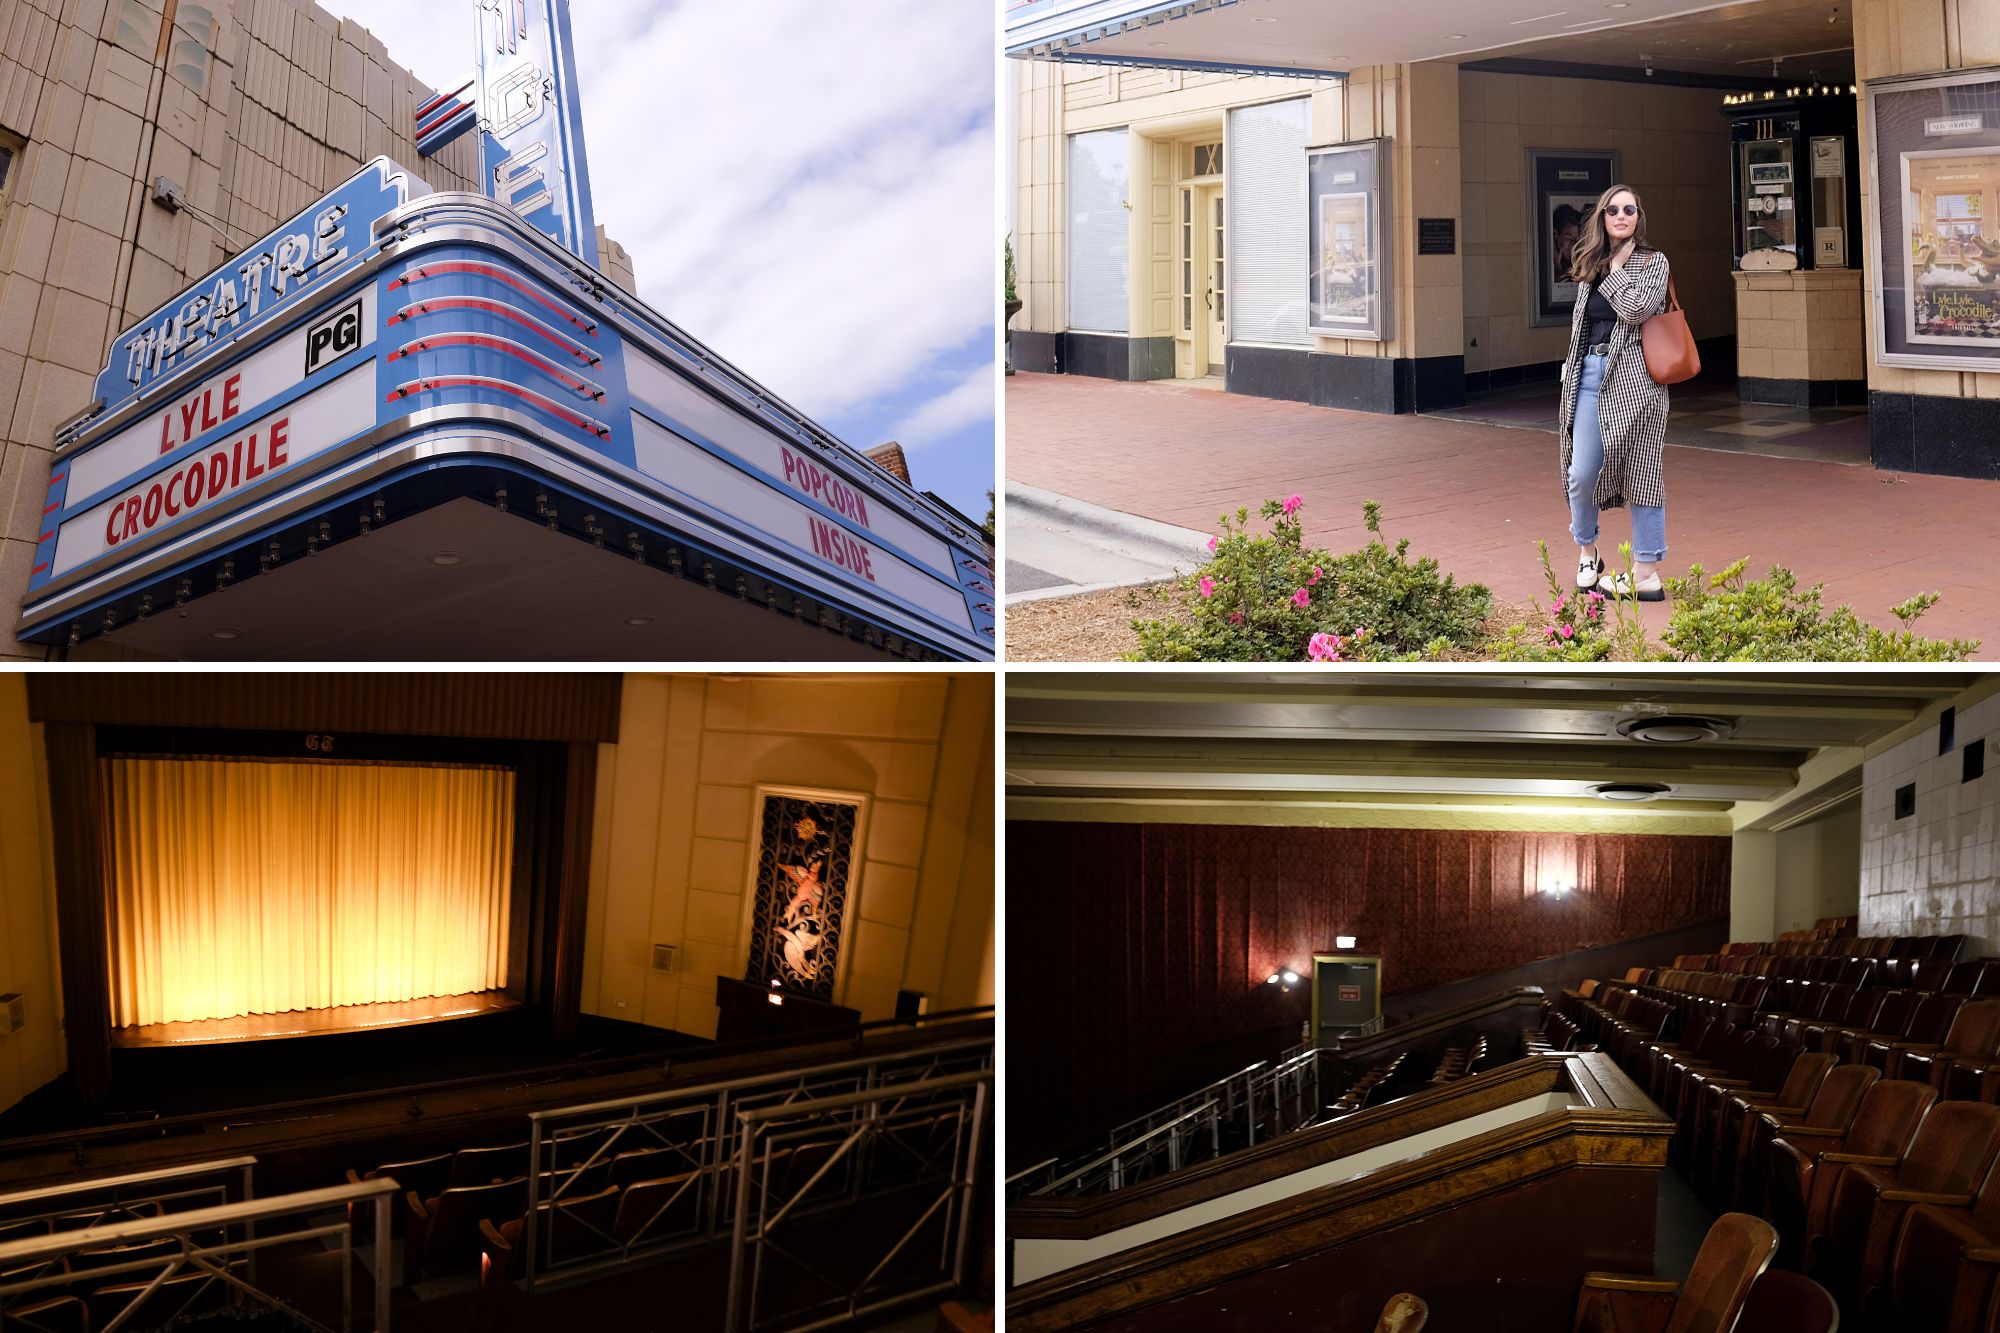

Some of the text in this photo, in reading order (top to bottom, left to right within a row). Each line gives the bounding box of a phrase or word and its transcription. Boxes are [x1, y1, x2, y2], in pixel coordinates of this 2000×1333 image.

[1824, 242, 1834, 251] R
[125, 202, 350, 390] THEATRE
[1939, 302, 1992, 321] Crocodile
[309, 311, 358, 366] PG
[159, 372, 242, 456] LYLE
[105, 416, 290, 547] CROCODILE
[780, 446, 870, 529] POPCORN
[808, 516, 876, 583] INSIDE
